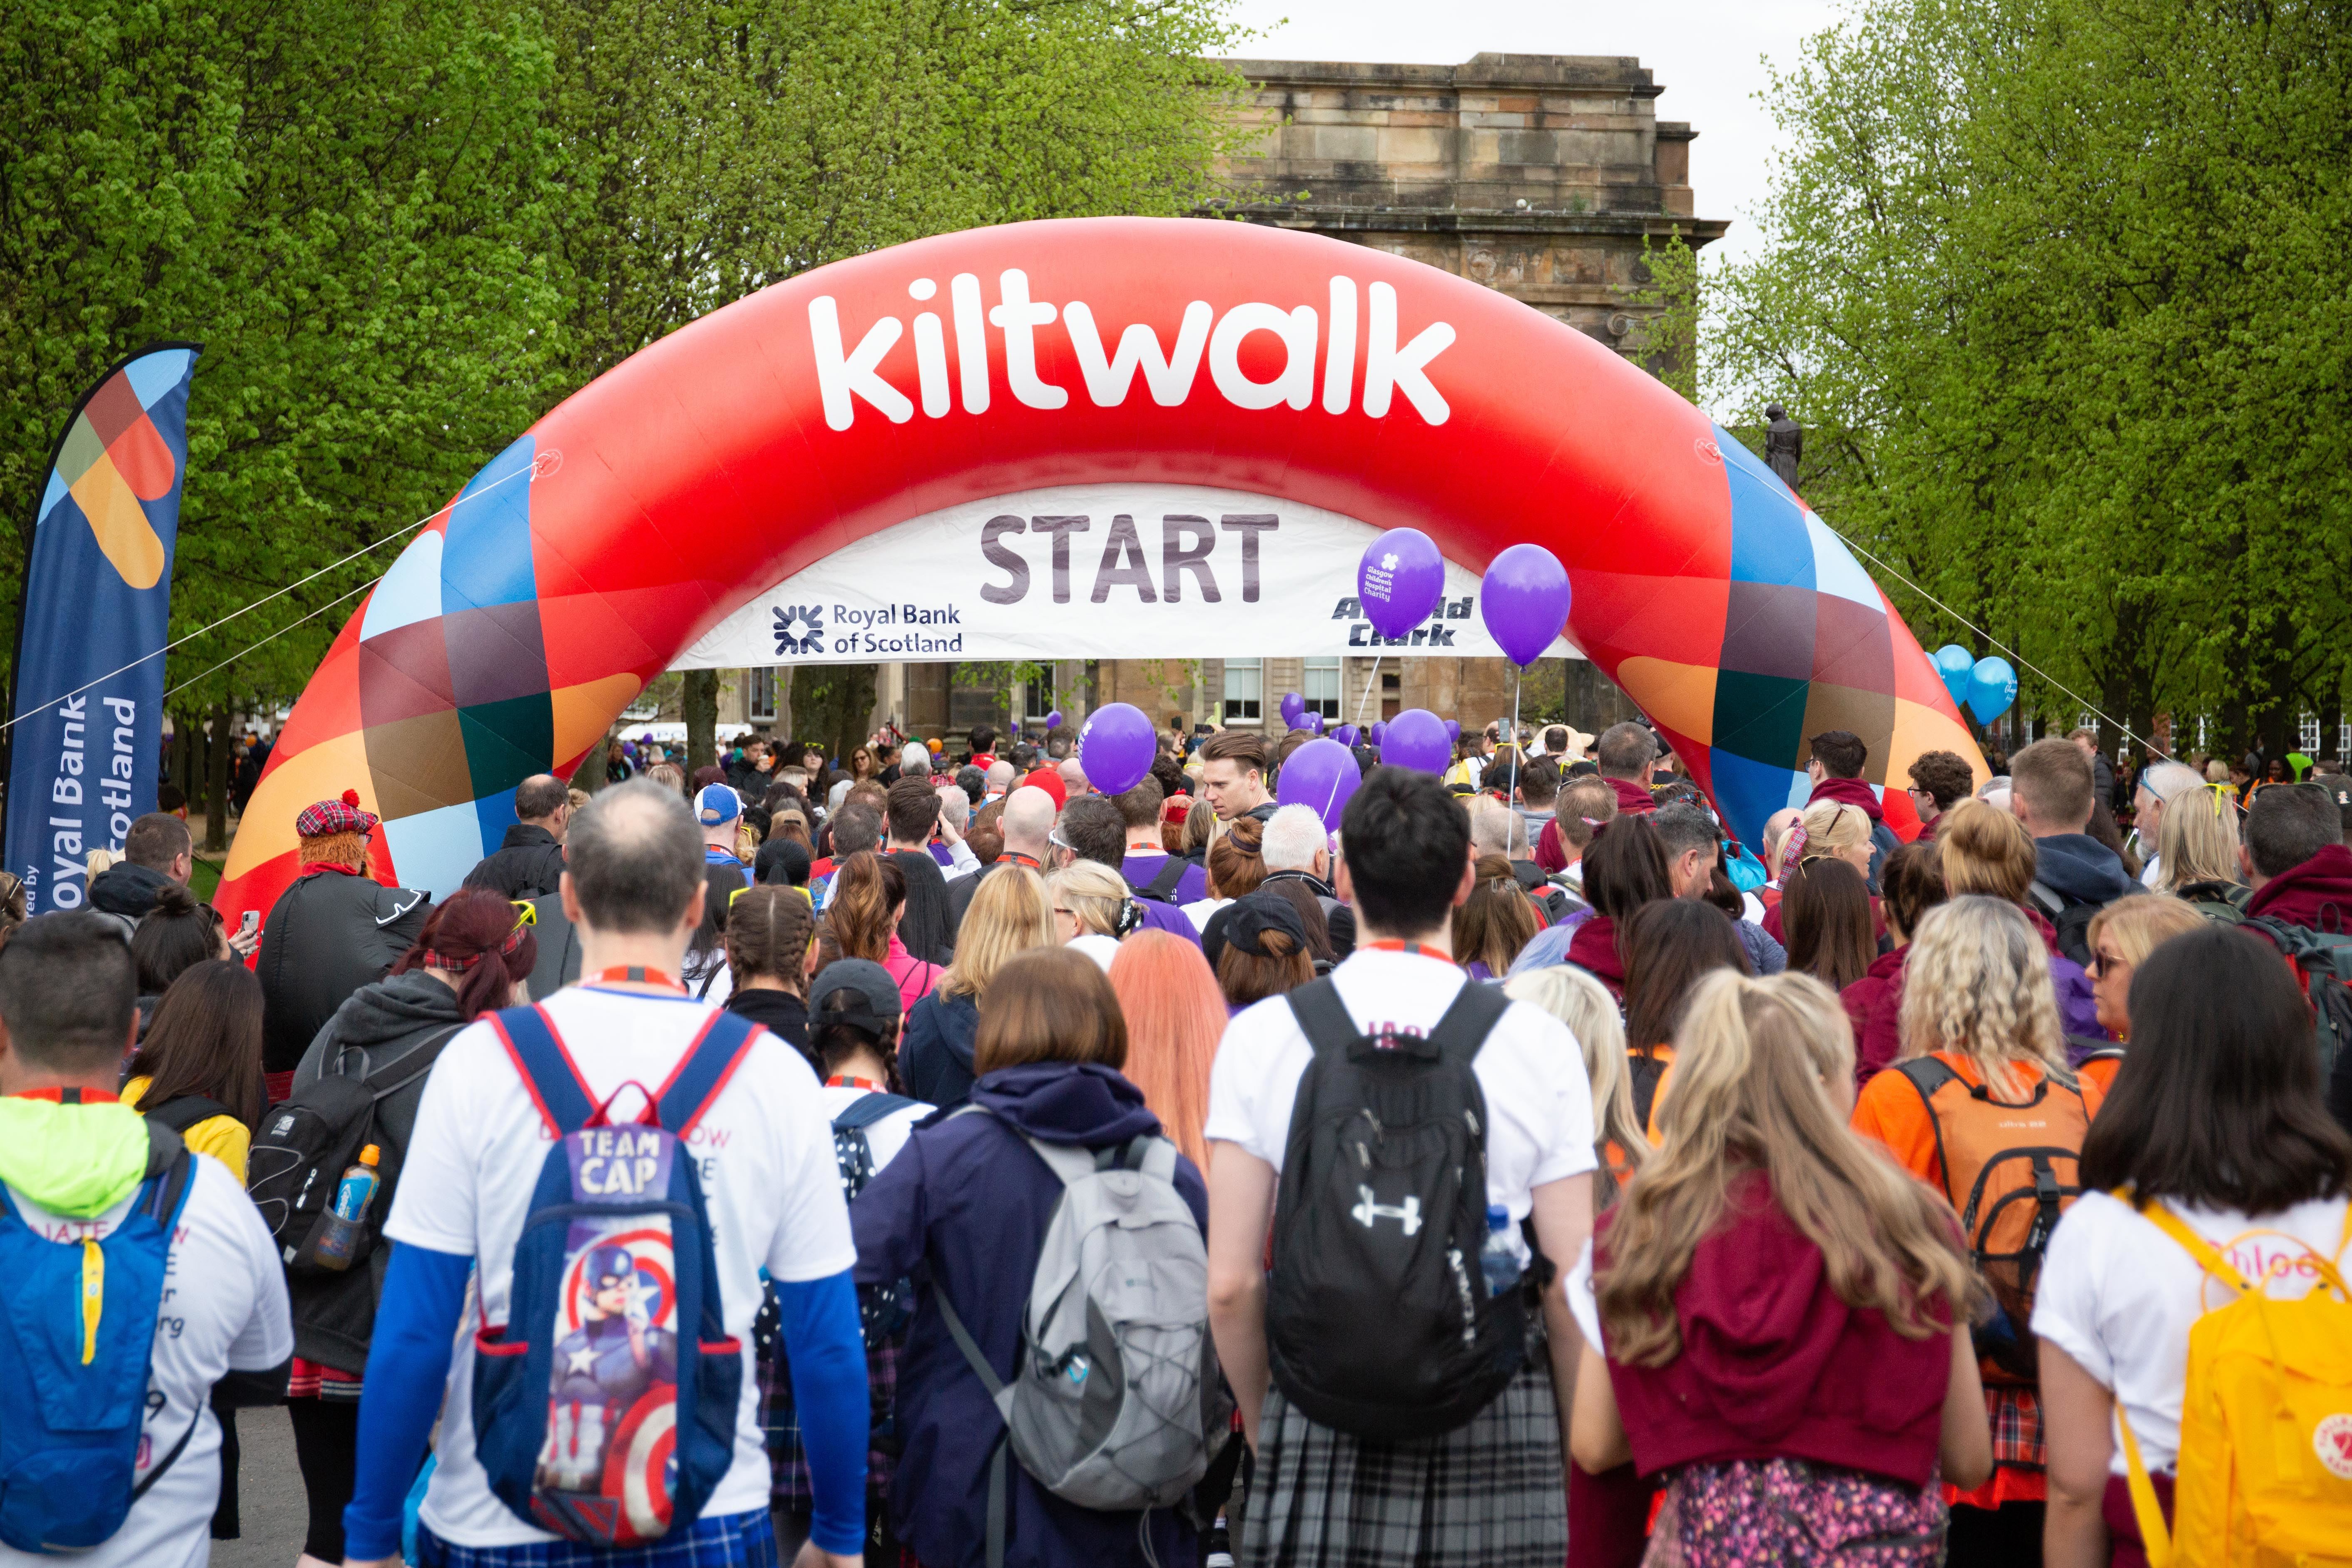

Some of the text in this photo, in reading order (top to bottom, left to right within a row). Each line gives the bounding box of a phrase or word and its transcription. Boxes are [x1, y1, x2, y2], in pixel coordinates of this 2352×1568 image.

[808, 268, 1456, 431] kiltwalk
[980, 513, 1279, 605] START
[1366, 574, 1392, 586] Children's
[1367, 566, 1394, 579] Glasgow
[1364, 587, 1391, 602] Charity
[1365, 580, 1391, 593] Hospital
[834, 603, 961, 630] Royal Bank
[1331, 596, 1474, 620] Ald
[834, 632, 962, 653] of Scotland
[100, 697, 135, 854] otland
[49, 695, 87, 909] oyal Bank
[23, 864, 40, 885] by
[578, 1130, 660, 1158] TEAM
[580, 1157, 657, 1195] CAP
